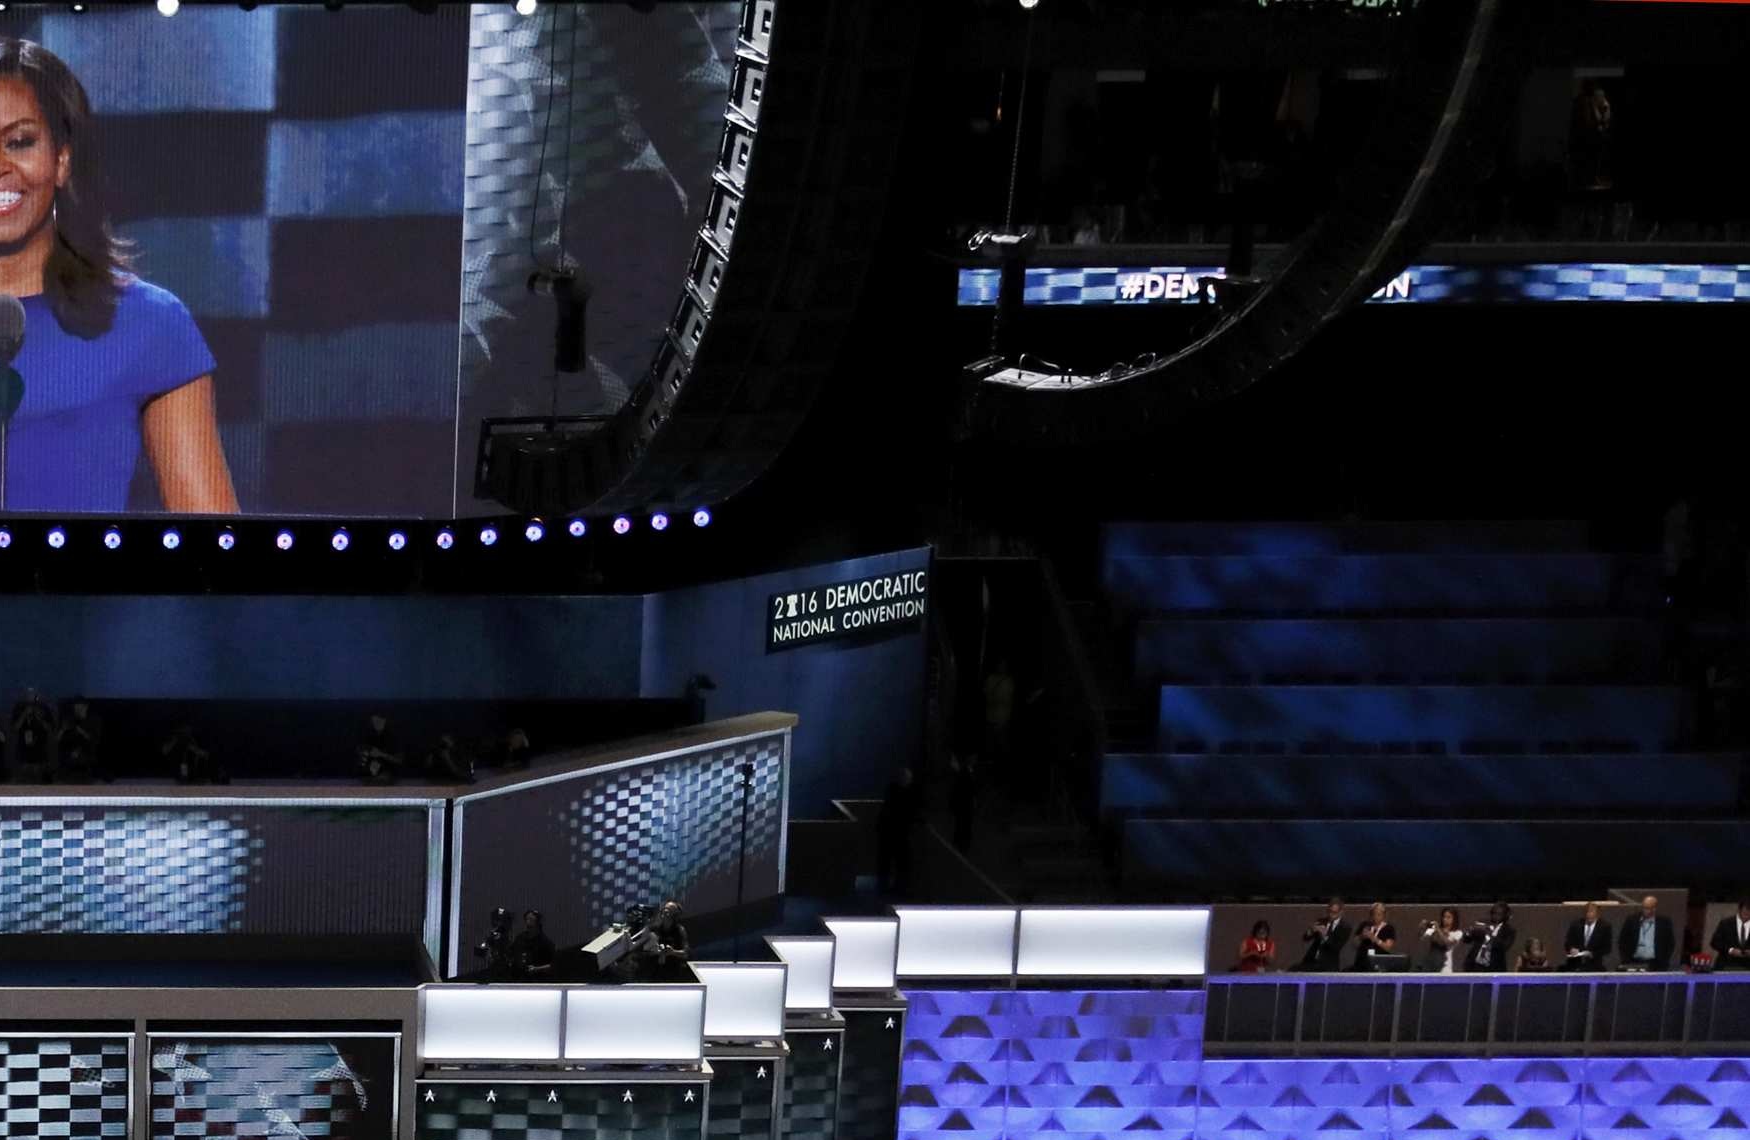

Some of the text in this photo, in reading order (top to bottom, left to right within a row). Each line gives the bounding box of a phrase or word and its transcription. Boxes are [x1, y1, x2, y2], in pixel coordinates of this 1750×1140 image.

[826, 571, 925, 610] DEMOCRATIC
[773, 599, 924, 642] NATIONAL CONVENTION
